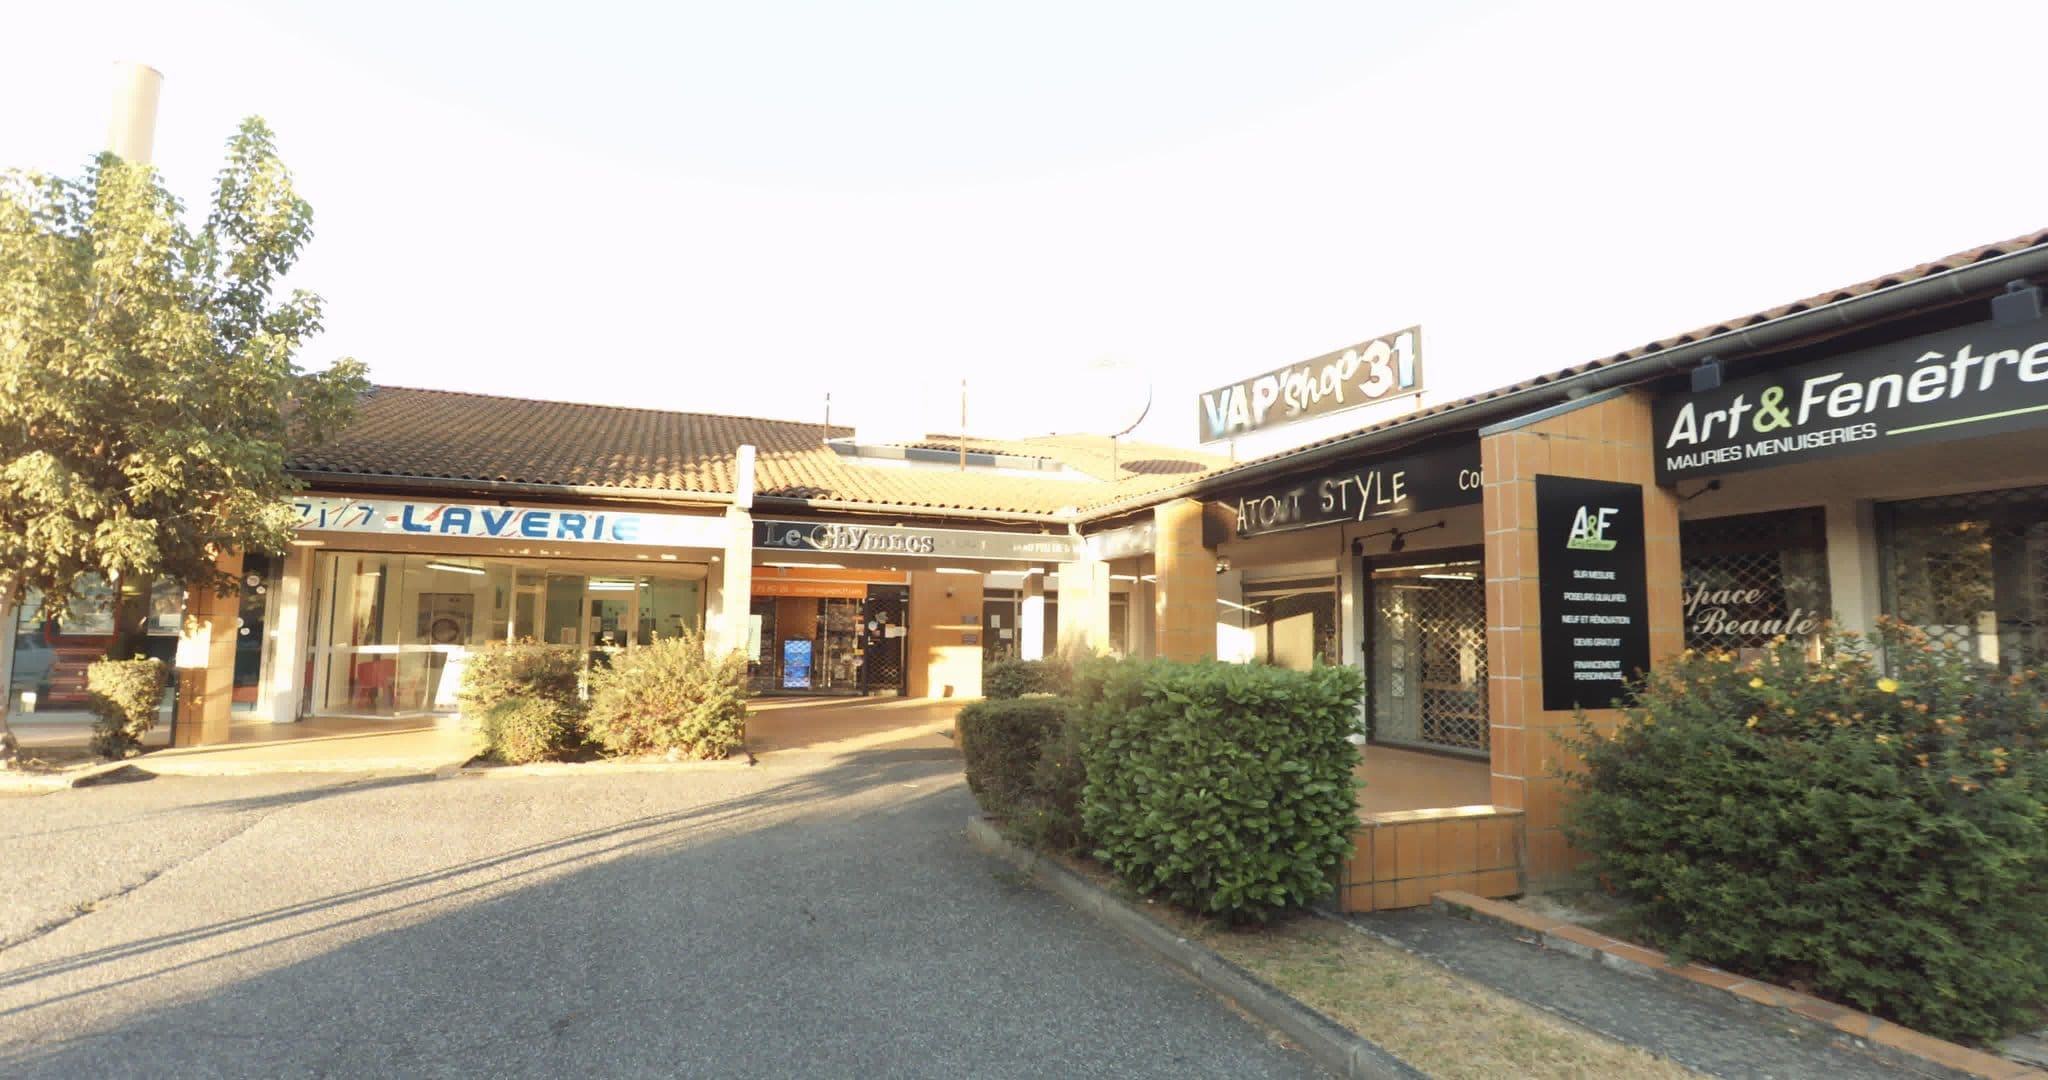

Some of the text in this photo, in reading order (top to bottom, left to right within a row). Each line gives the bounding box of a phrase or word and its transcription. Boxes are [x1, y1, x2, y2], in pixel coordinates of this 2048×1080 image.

[1666, 422, 1878, 472] MAURIES MENUISERIES
[1236, 489, 1304, 532] ATOUT
[1321, 470, 1407, 521] STYLE
[401, 504, 640, 541] LAVERIE
[764, 521, 801, 547] Le
[1566, 505, 1619, 547] A&F
[1573, 570, 1616, 580] SUR MESURE
[1564, 592, 1595, 602] POSEURS
[1561, 615, 1579, 624] NEUF
[1580, 615, 1588, 624] ET
[1693, 607, 1818, 635] Beauté
[1573, 638, 1621, 647] DEVIS GRATUIT
[1573, 661, 1621, 670] FINANCEMENT
